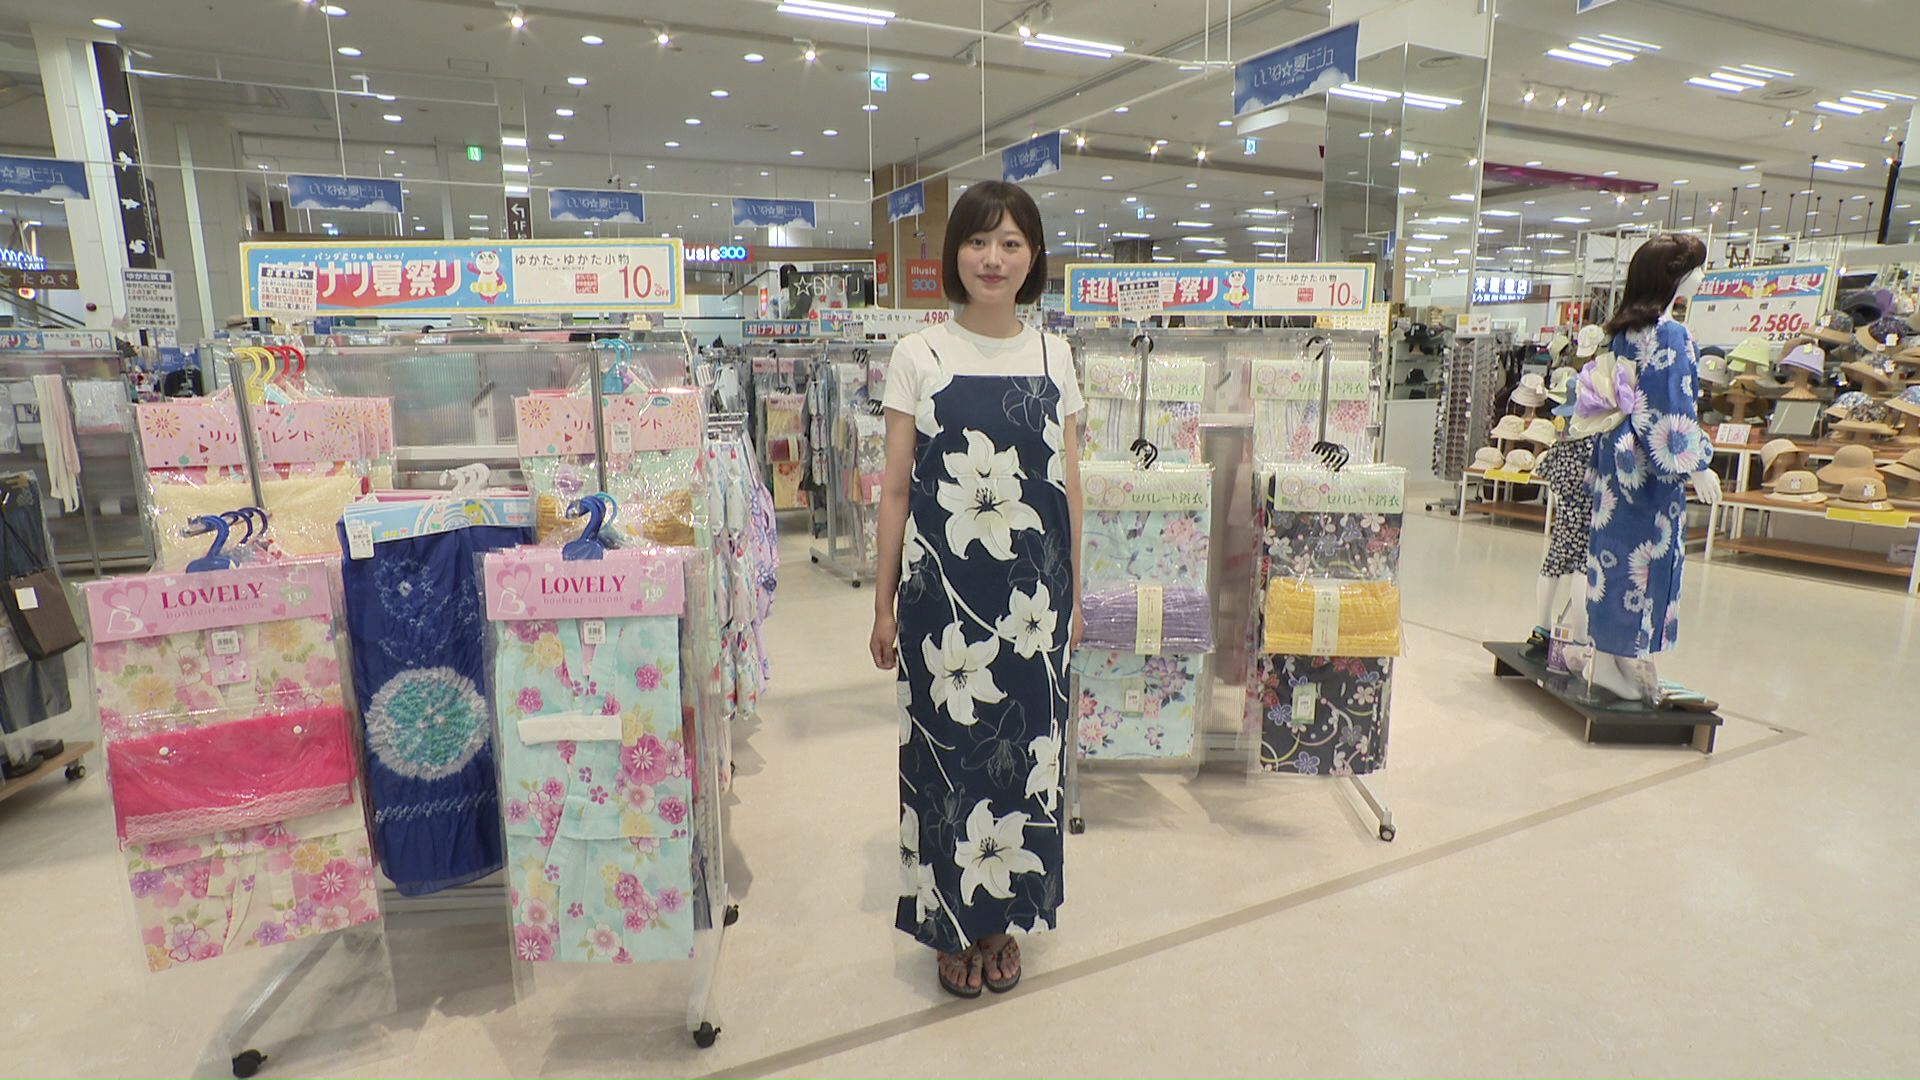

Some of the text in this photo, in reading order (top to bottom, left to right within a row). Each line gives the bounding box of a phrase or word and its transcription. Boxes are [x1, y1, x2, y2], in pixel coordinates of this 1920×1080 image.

[513, 220, 527, 231] 1F
[618, 264, 652, 299] 10
[1328, 282, 1351, 306] 10
[88, 334, 103, 349] 10
[541, 575, 627, 594] LOVELY
[645, 587, 663, 599] 130
[161, 582, 264, 609] LOVELY
